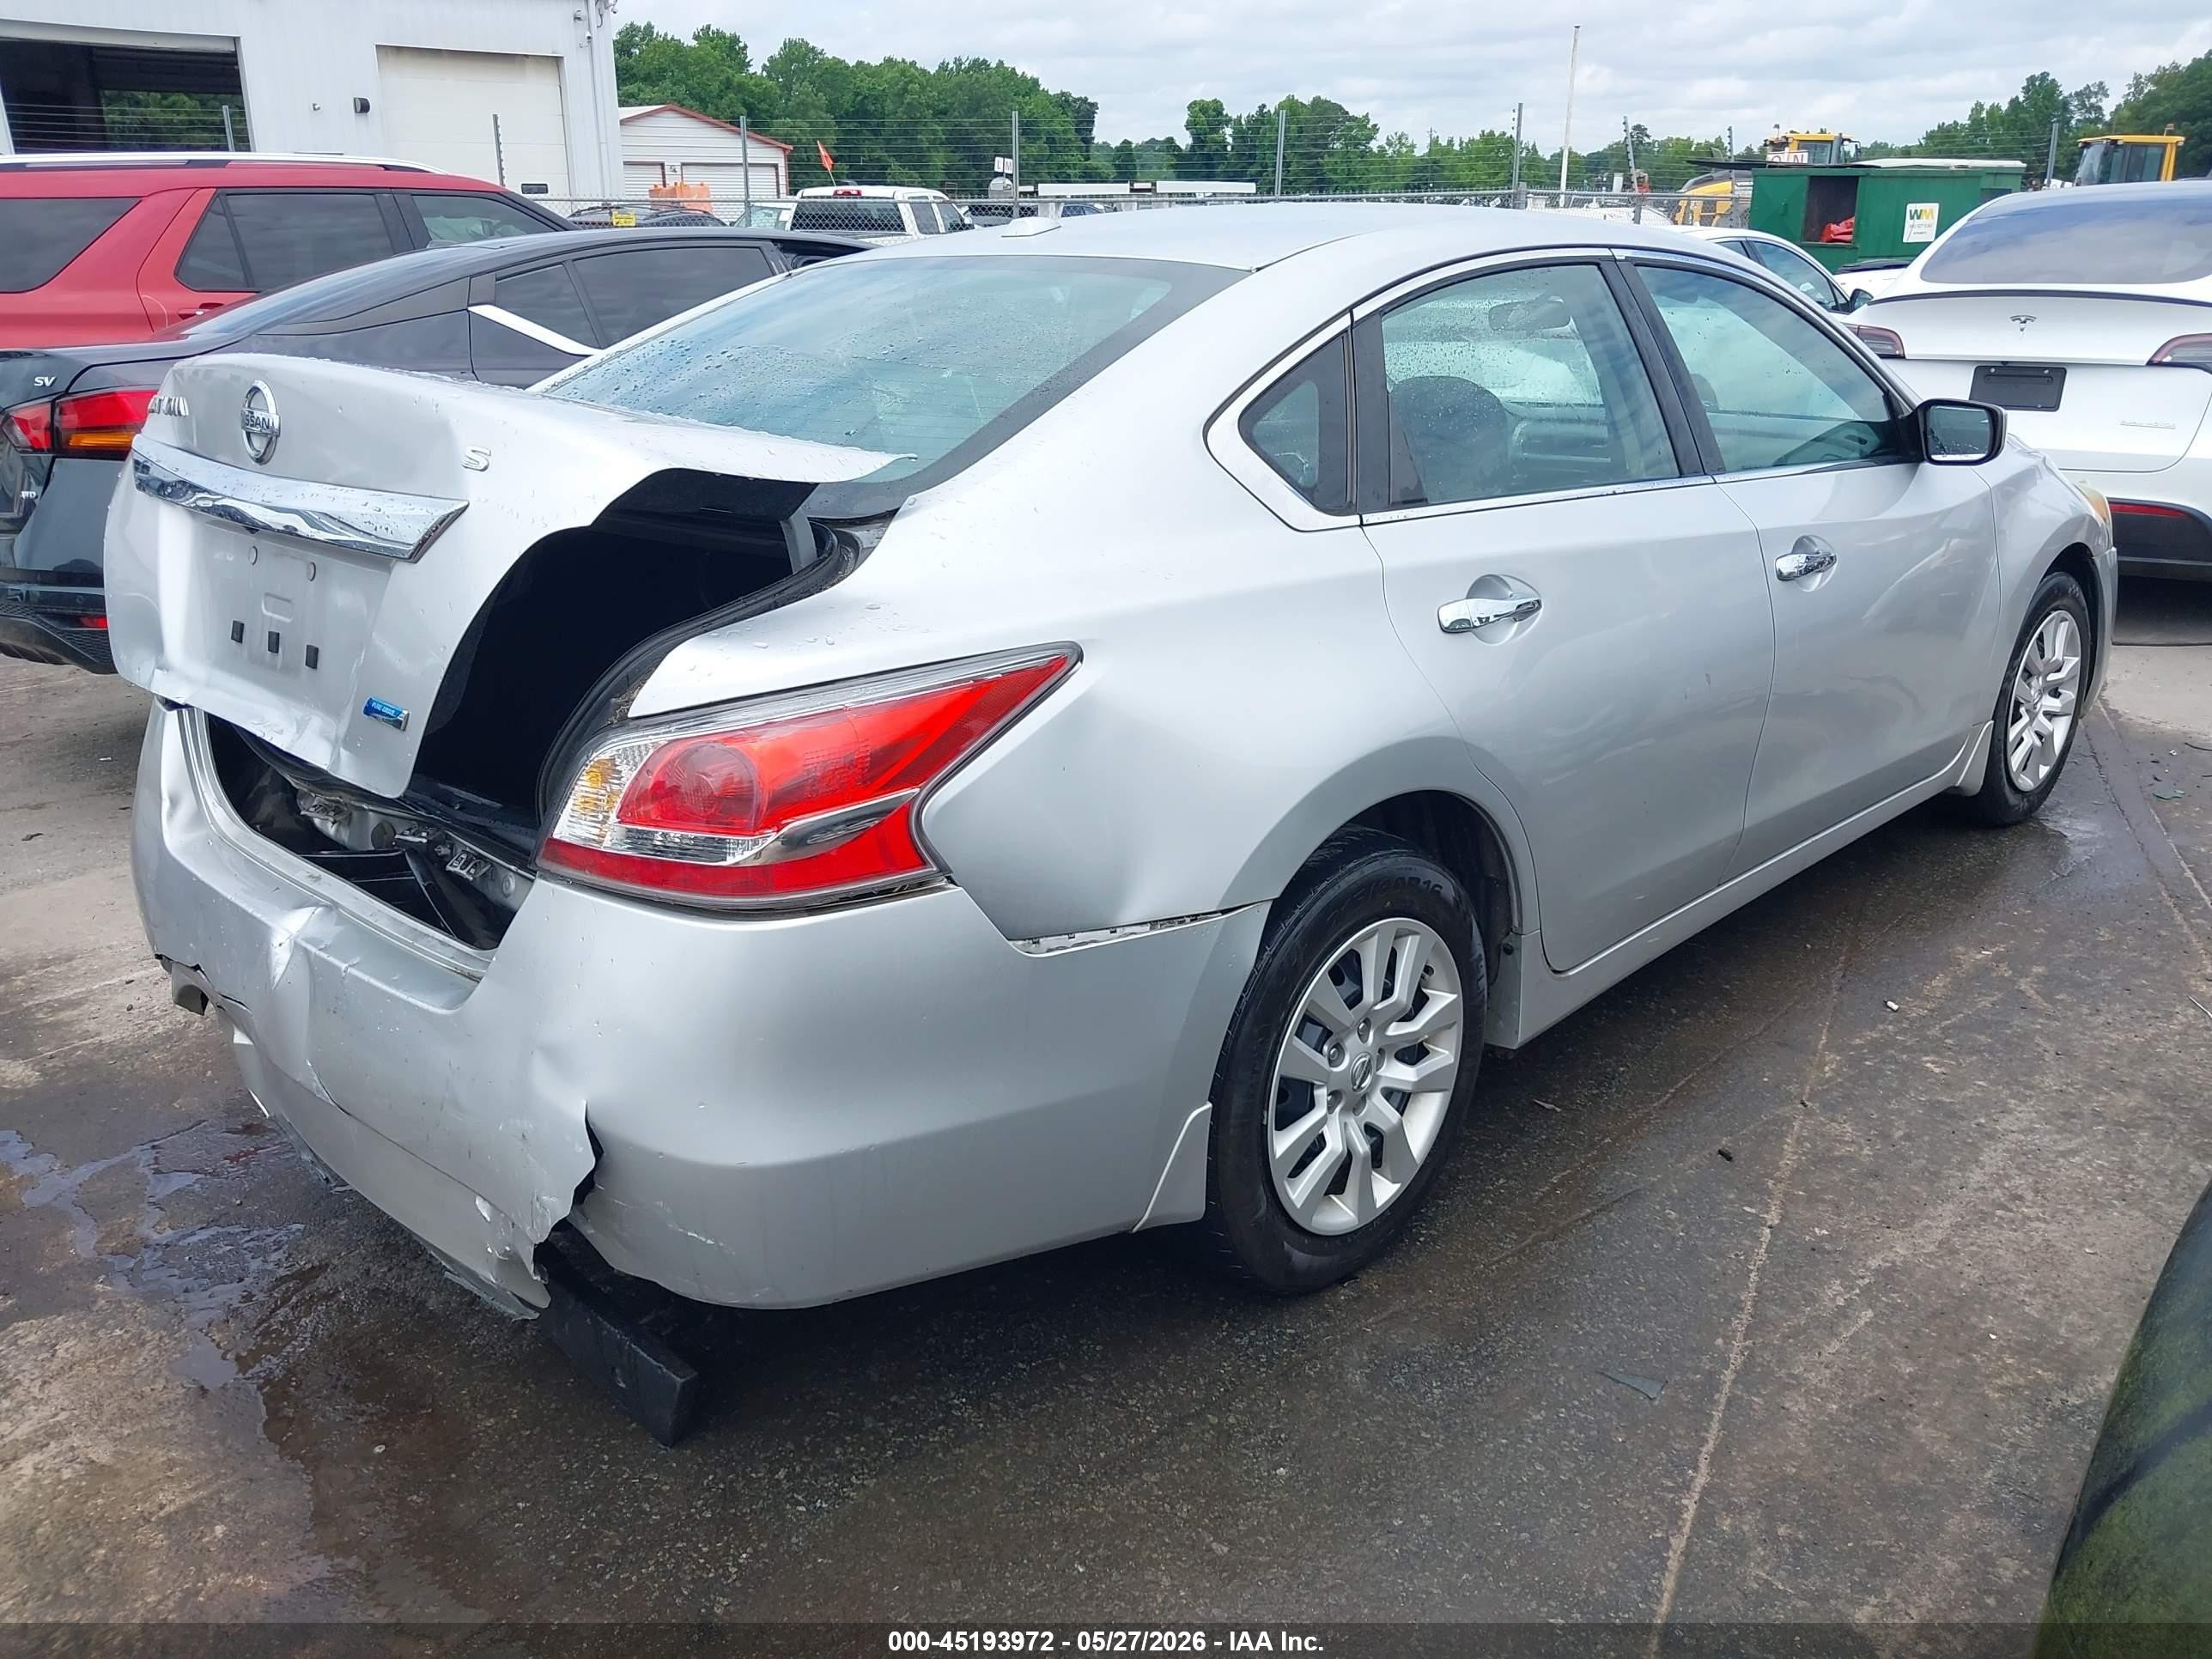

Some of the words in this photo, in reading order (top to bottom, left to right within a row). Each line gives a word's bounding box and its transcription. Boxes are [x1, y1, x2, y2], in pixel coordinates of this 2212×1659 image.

[1909, 209, 1935, 221] WM
[33, 376, 56, 386] SV
[461, 446, 492, 472] S
